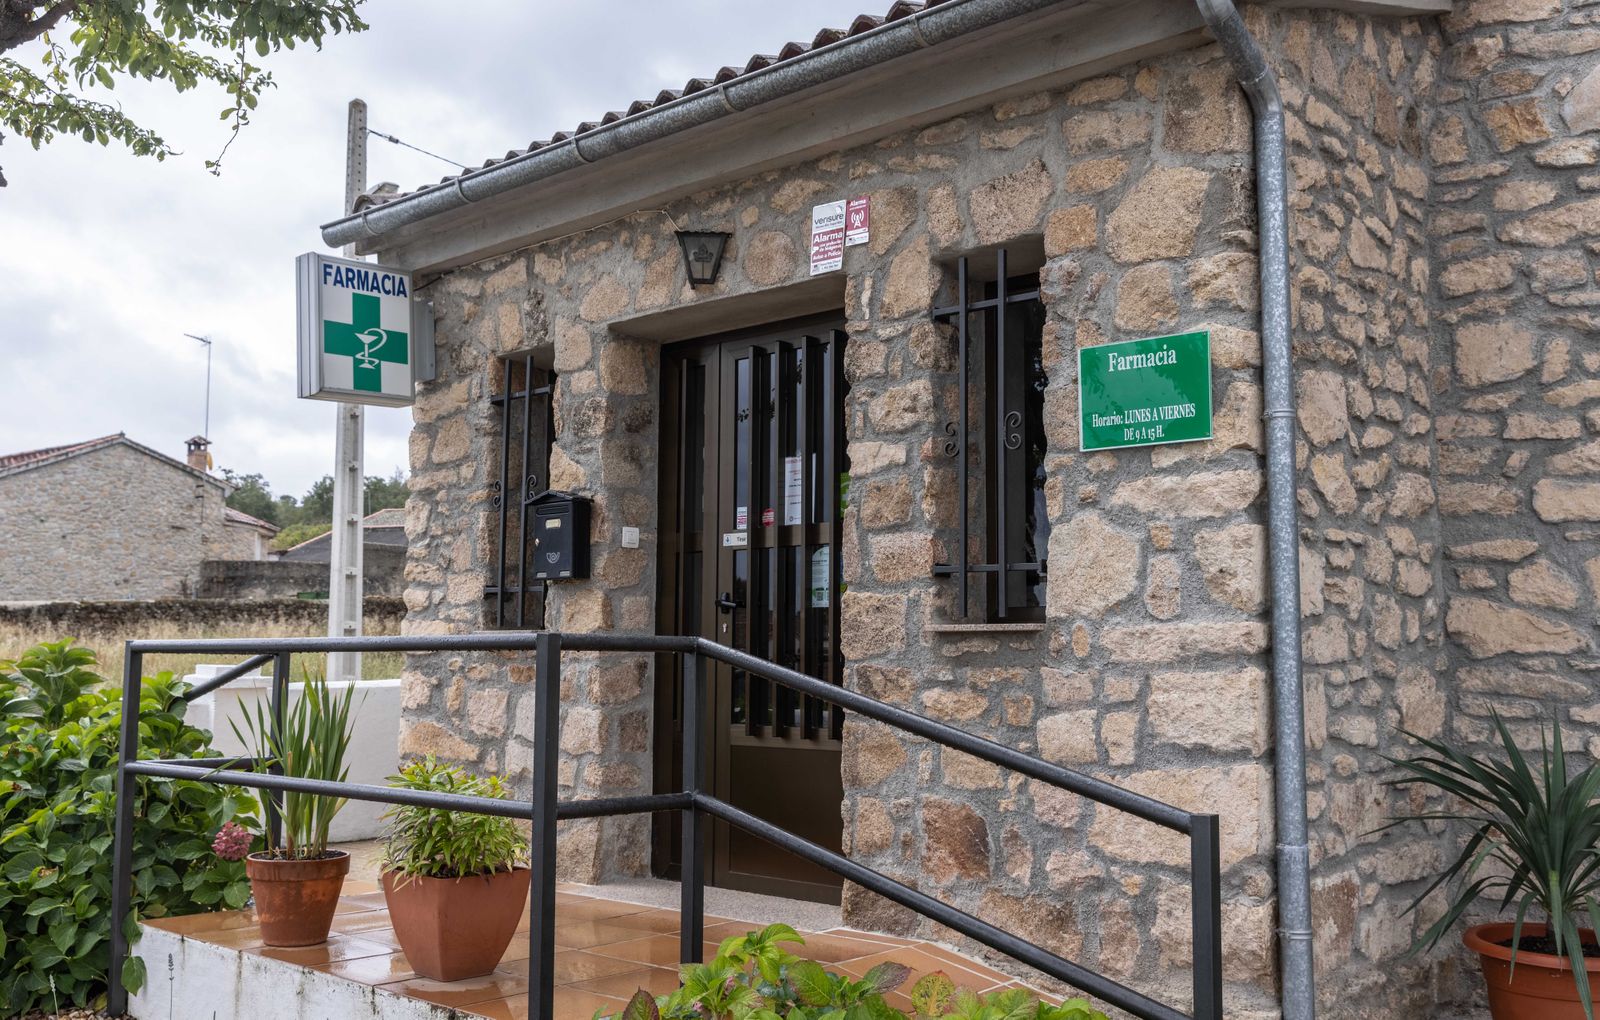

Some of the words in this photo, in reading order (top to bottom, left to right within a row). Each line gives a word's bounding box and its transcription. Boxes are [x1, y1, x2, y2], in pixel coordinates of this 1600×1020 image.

[815, 213, 844, 225] verisure
[814, 232, 843, 243] Alarma
[324, 264, 407, 297] FARMACIA
[1108, 344, 1177, 372] Farmacia
[1092, 411, 1123, 427] Horario:
[1124, 407, 1151, 424] LUNES
[1152, 407, 1158, 421] A
[1159, 403, 1196, 420] VIERNES
[1124, 428, 1135, 441] DE
[1135, 430, 1140, 443] 9
[1141, 427, 1147, 439] A
[1148, 427, 1155, 441] 15
[1156, 425, 1165, 437] H.
